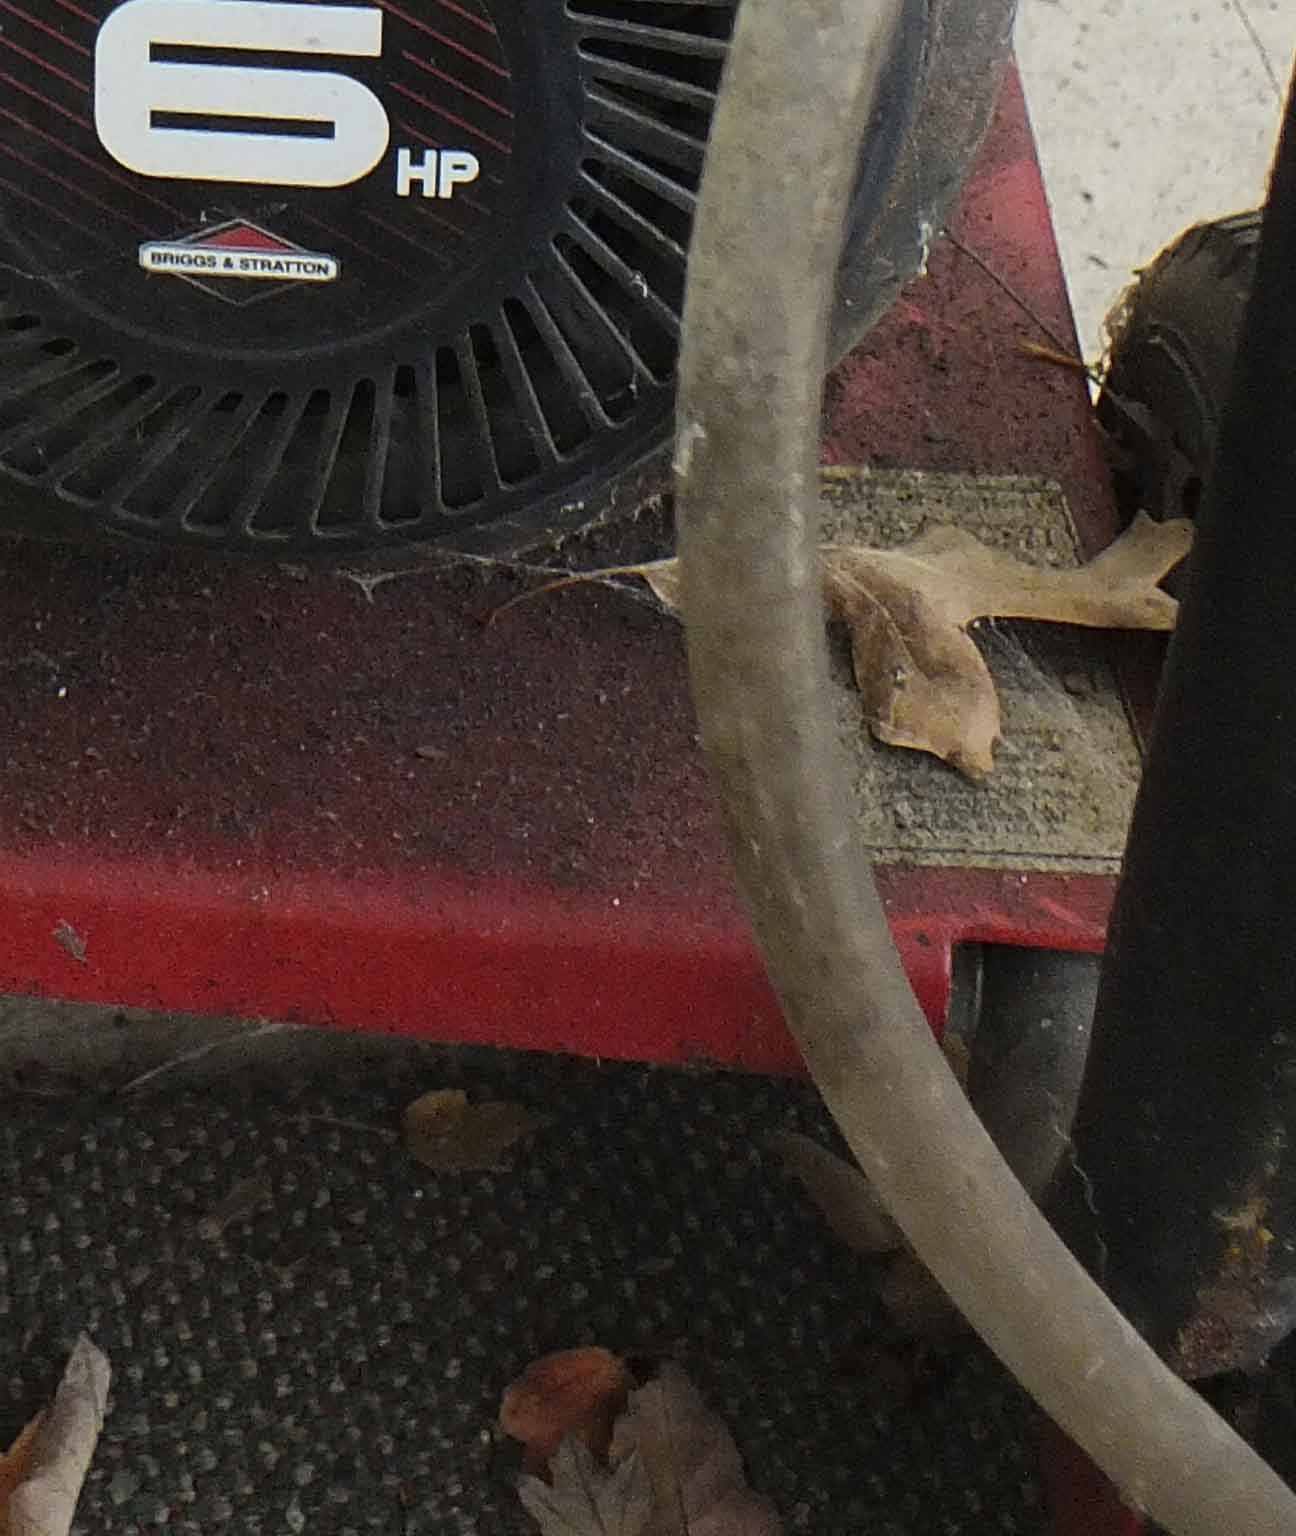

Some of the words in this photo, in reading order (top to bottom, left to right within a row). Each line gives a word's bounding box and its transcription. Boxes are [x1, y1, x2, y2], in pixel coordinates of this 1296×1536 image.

[396, 147, 480, 199] HP
[150, 251, 218, 269] BRIGGS
[222, 256, 234, 270] &
[238, 257, 331, 277] STRATTON
